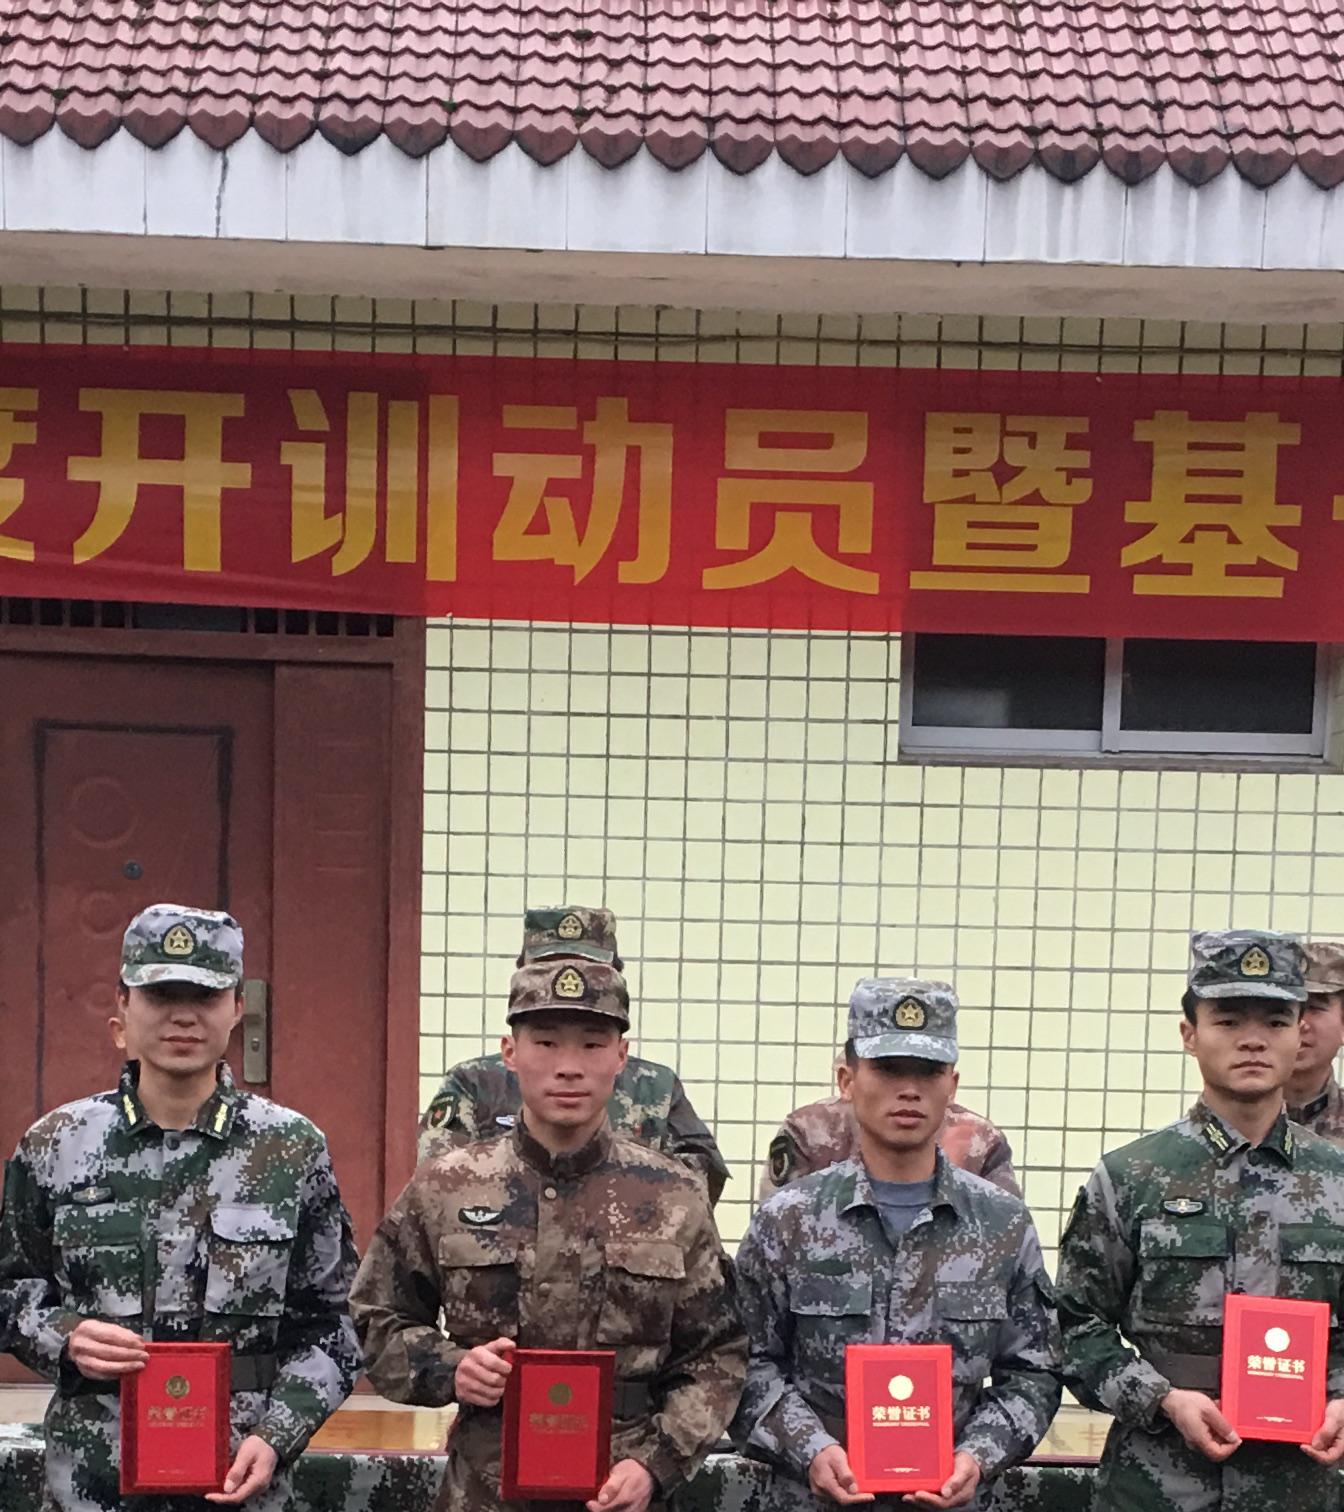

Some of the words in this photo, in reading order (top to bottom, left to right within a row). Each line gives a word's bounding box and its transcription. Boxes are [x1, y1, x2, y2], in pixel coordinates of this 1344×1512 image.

[1246, 1354, 1306, 1374] 荣誉证书
[872, 1406, 931, 1421] 荣誉证书
